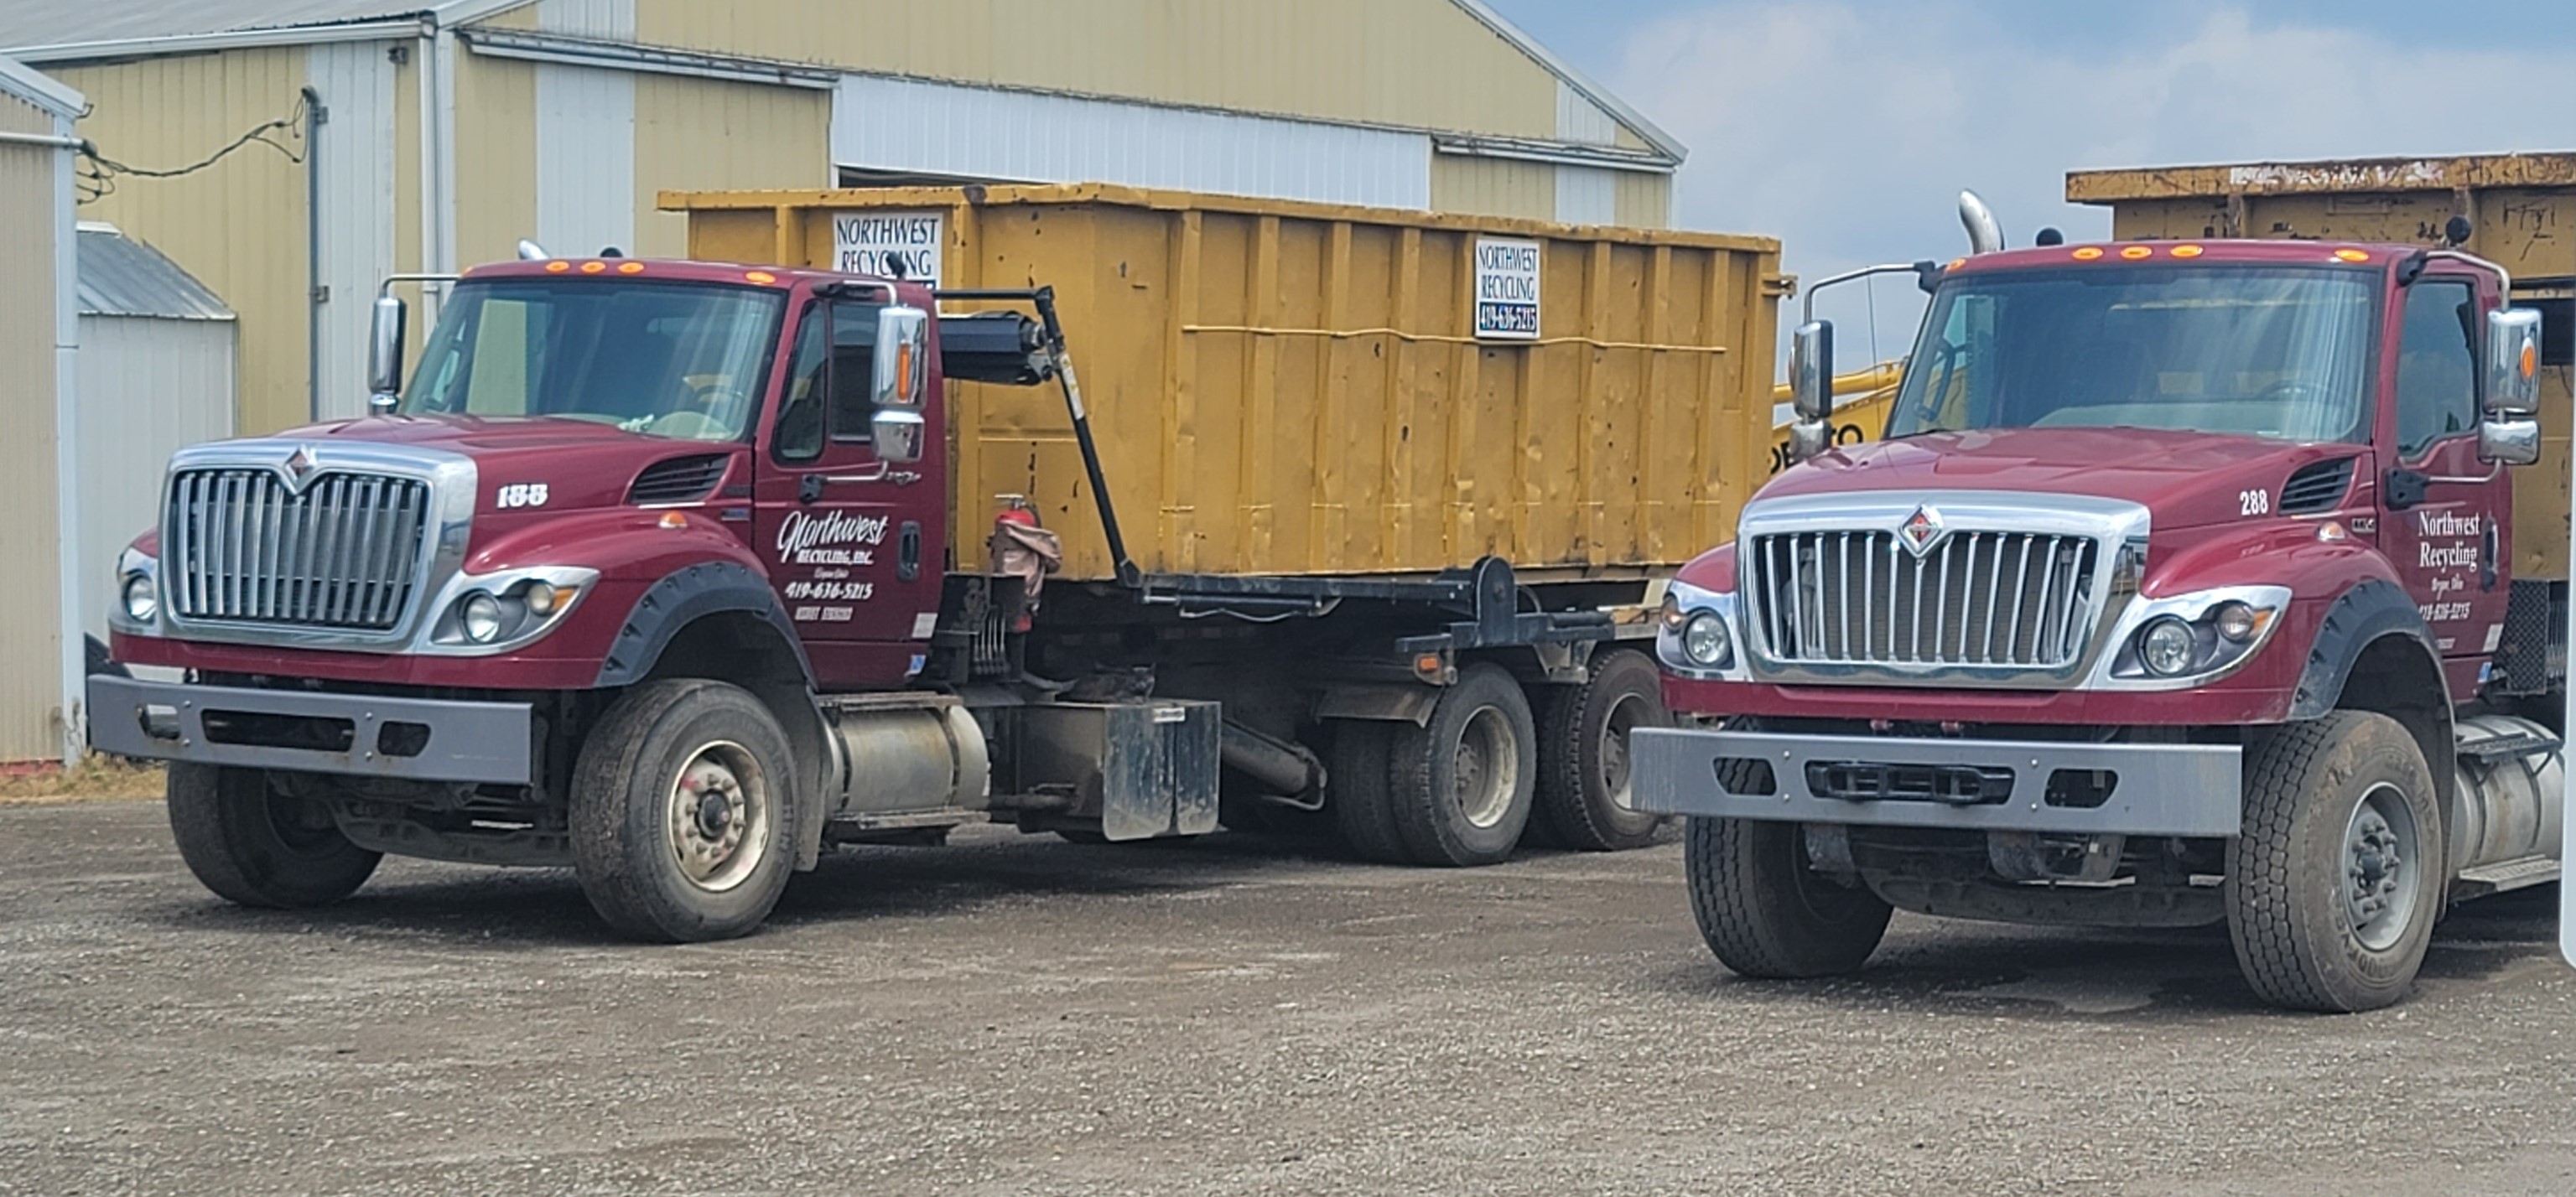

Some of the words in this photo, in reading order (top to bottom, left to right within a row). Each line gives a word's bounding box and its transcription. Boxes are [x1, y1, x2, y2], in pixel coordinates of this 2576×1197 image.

[837, 218, 938, 245] NORTHWEST
[842, 250, 931, 276] RECYCNG
[1479, 246, 1537, 272] NORTHWEST
[1482, 275, 1535, 301] RECYCLING
[496, 484, 548, 508] 188
[2240, 489, 2268, 516] 288
[777, 509, 889, 563] Northwest
[2418, 510, 2480, 536] Northwest
[2419, 541, 2477, 573] Recycling
[785, 582, 874, 599] 419-636-5215
